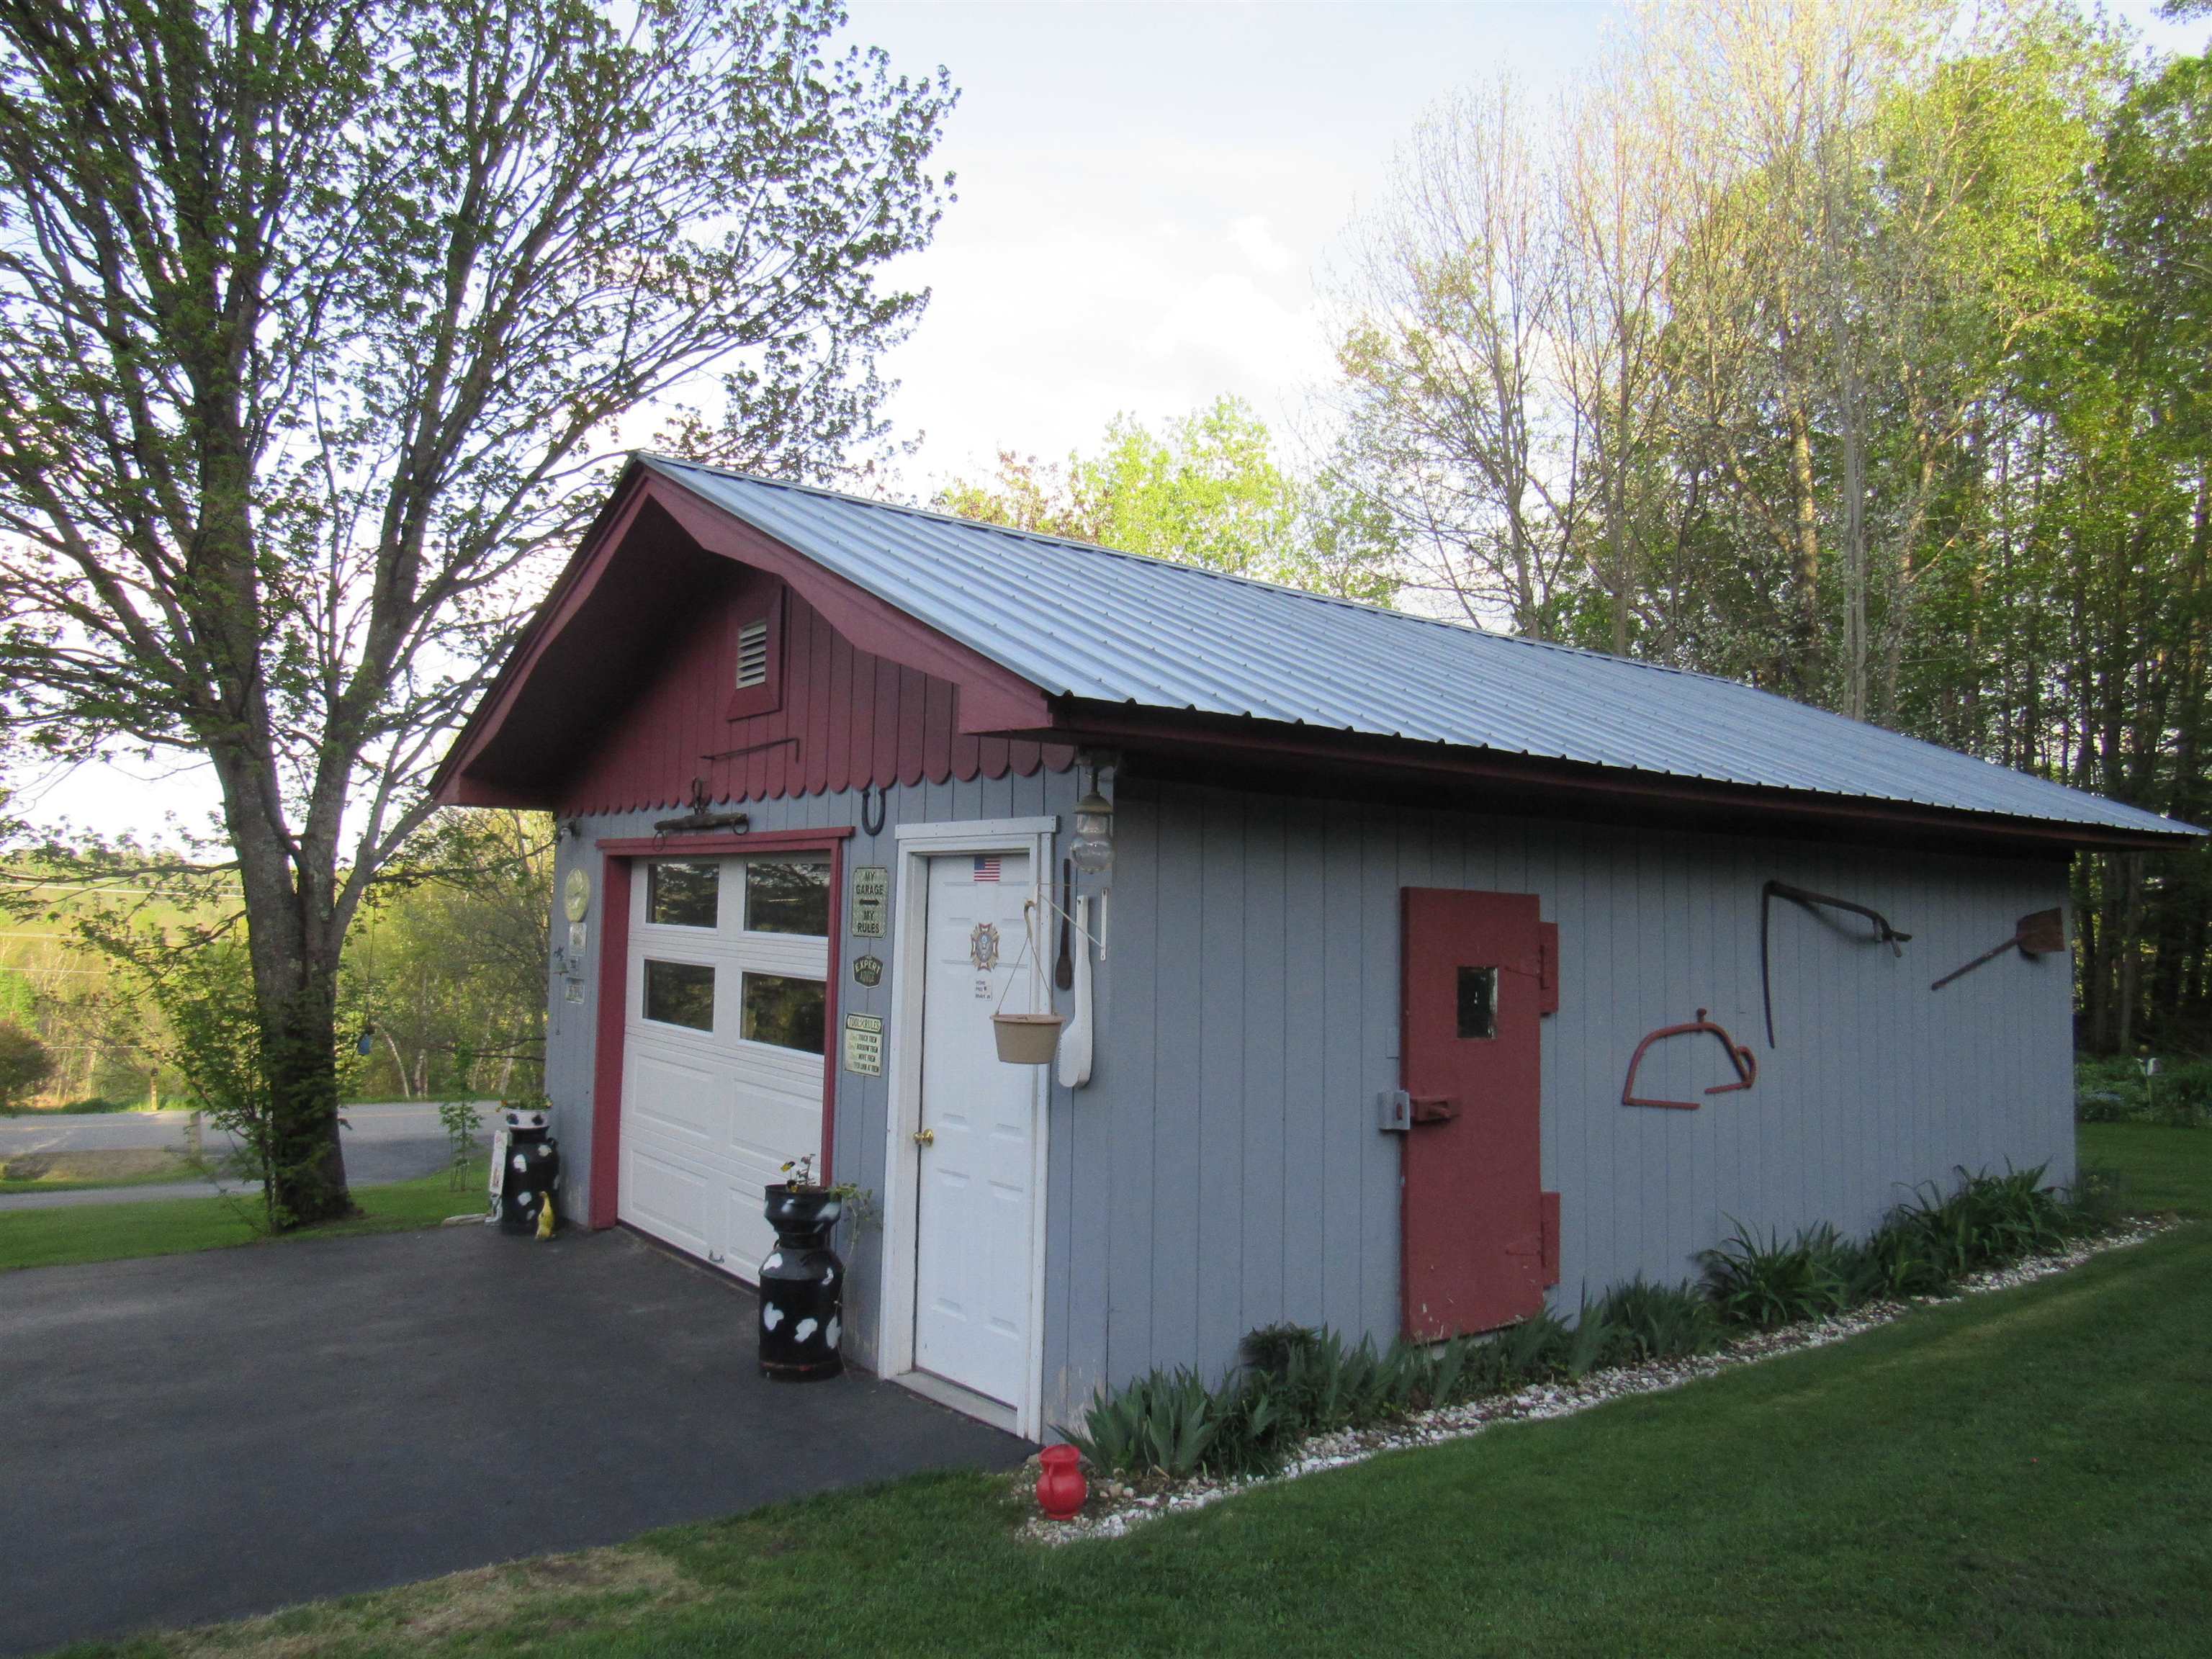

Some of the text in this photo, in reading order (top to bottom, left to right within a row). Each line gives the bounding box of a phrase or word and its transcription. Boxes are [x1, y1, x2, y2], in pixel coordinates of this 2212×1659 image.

[865, 871, 876, 881] MY
[855, 884, 884, 895] GARAGE
[863, 910, 875, 921] MY
[858, 922, 880, 934] RULES
[855, 959, 881, 974] EXPERT
